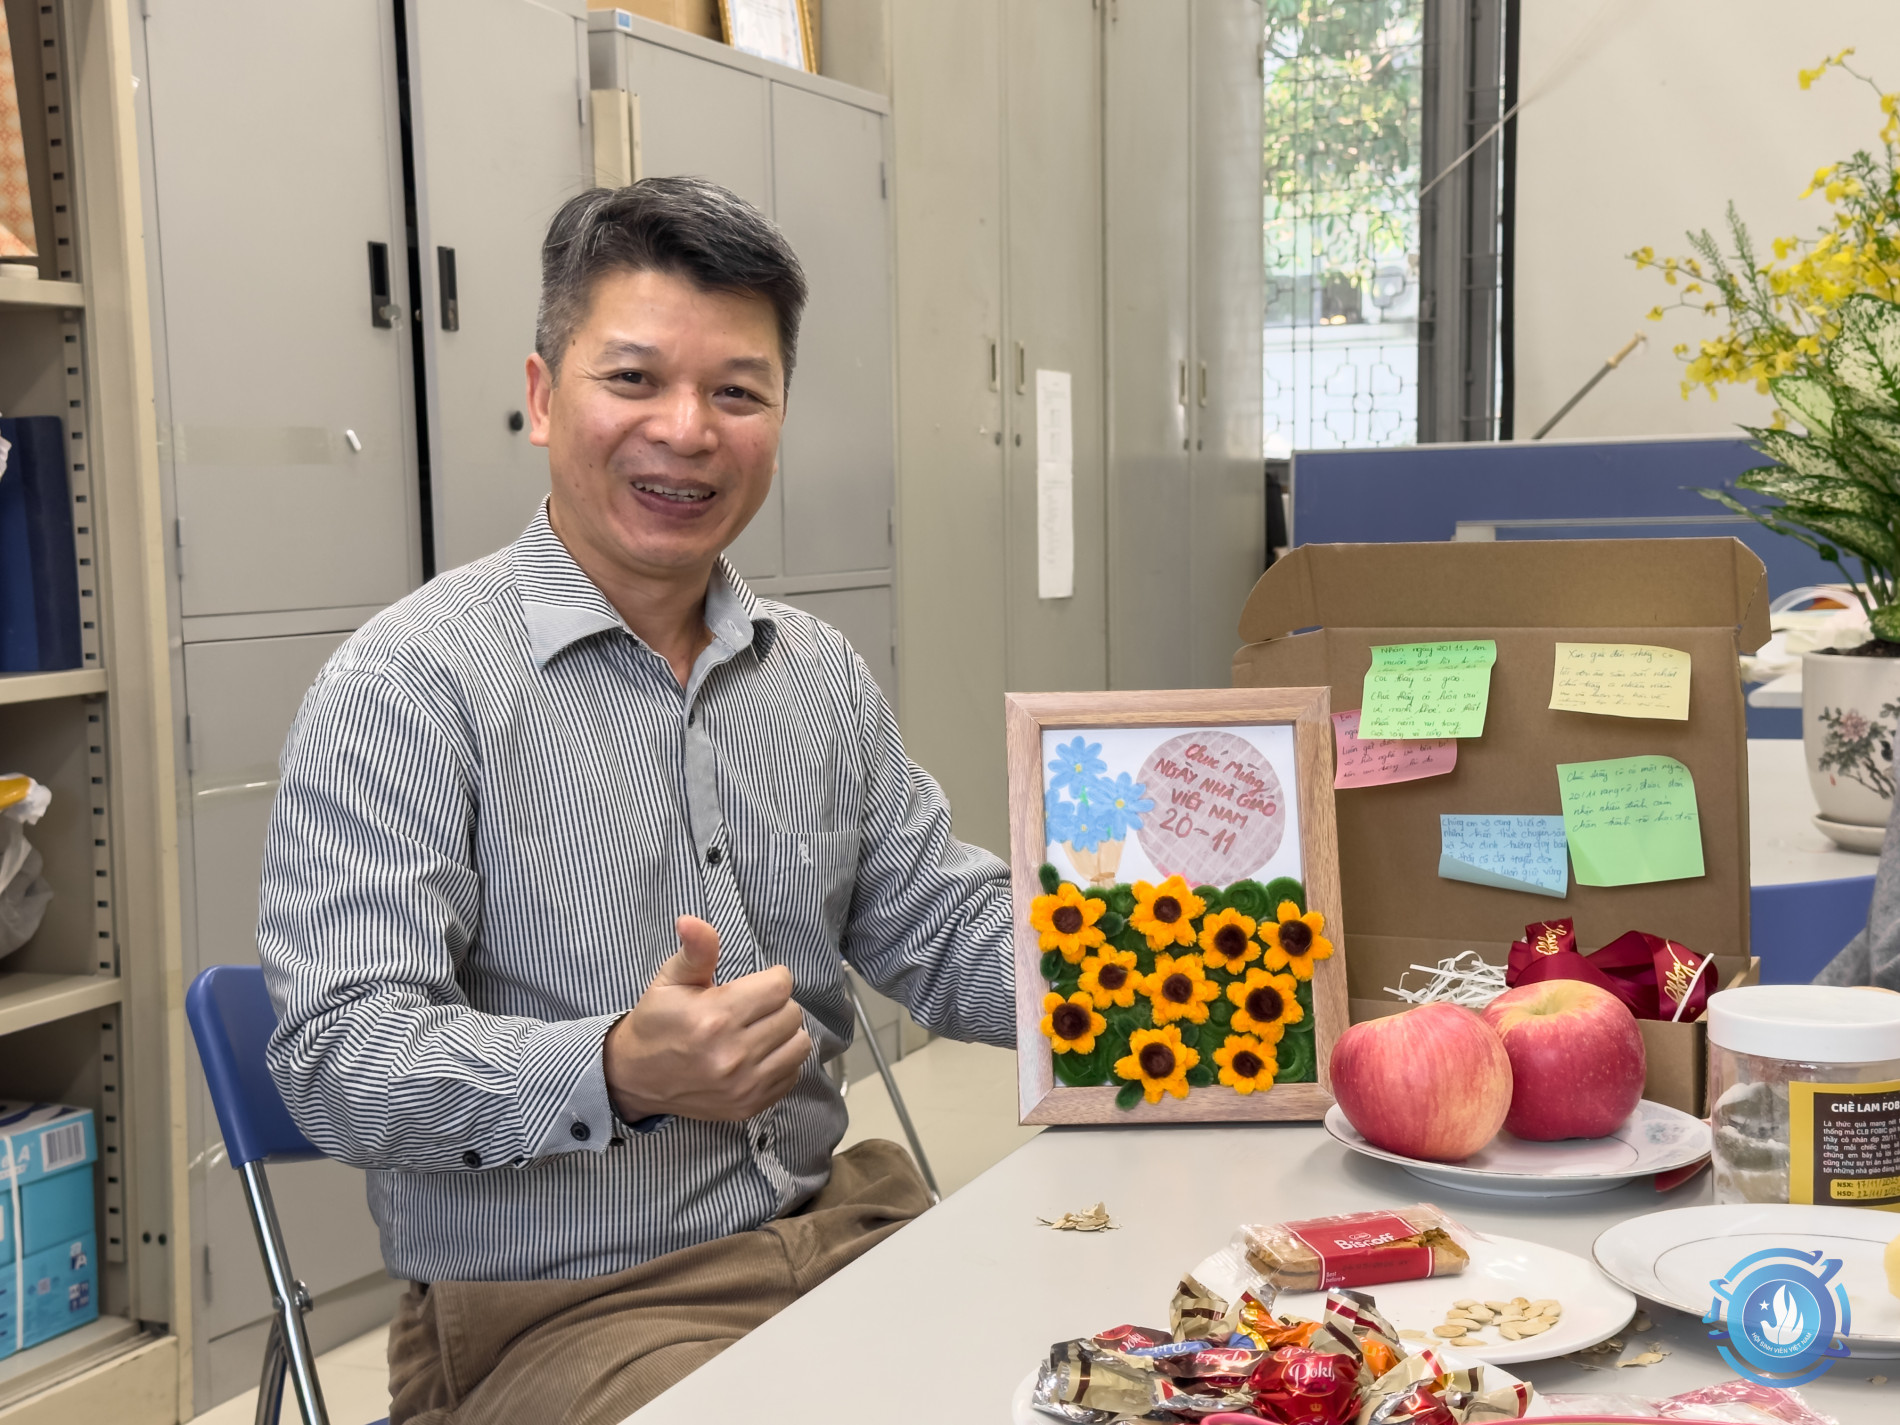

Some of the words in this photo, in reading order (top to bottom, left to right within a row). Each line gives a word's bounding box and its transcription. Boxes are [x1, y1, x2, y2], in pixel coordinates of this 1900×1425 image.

[1344, 726, 1358, 739] ngà
[1154, 758, 1198, 784] NGÀY
[1199, 778, 1239, 801] NHÀ
[1236, 794, 1277, 817] GIÁO
[1208, 804, 1248, 829] NAM
[1831, 1101, 1855, 1112] CHÈ
[1857, 1103, 1880, 1112] LAM
[1823, 1128, 1842, 1136] thống
[1823, 1135, 1838, 1143] thầy
